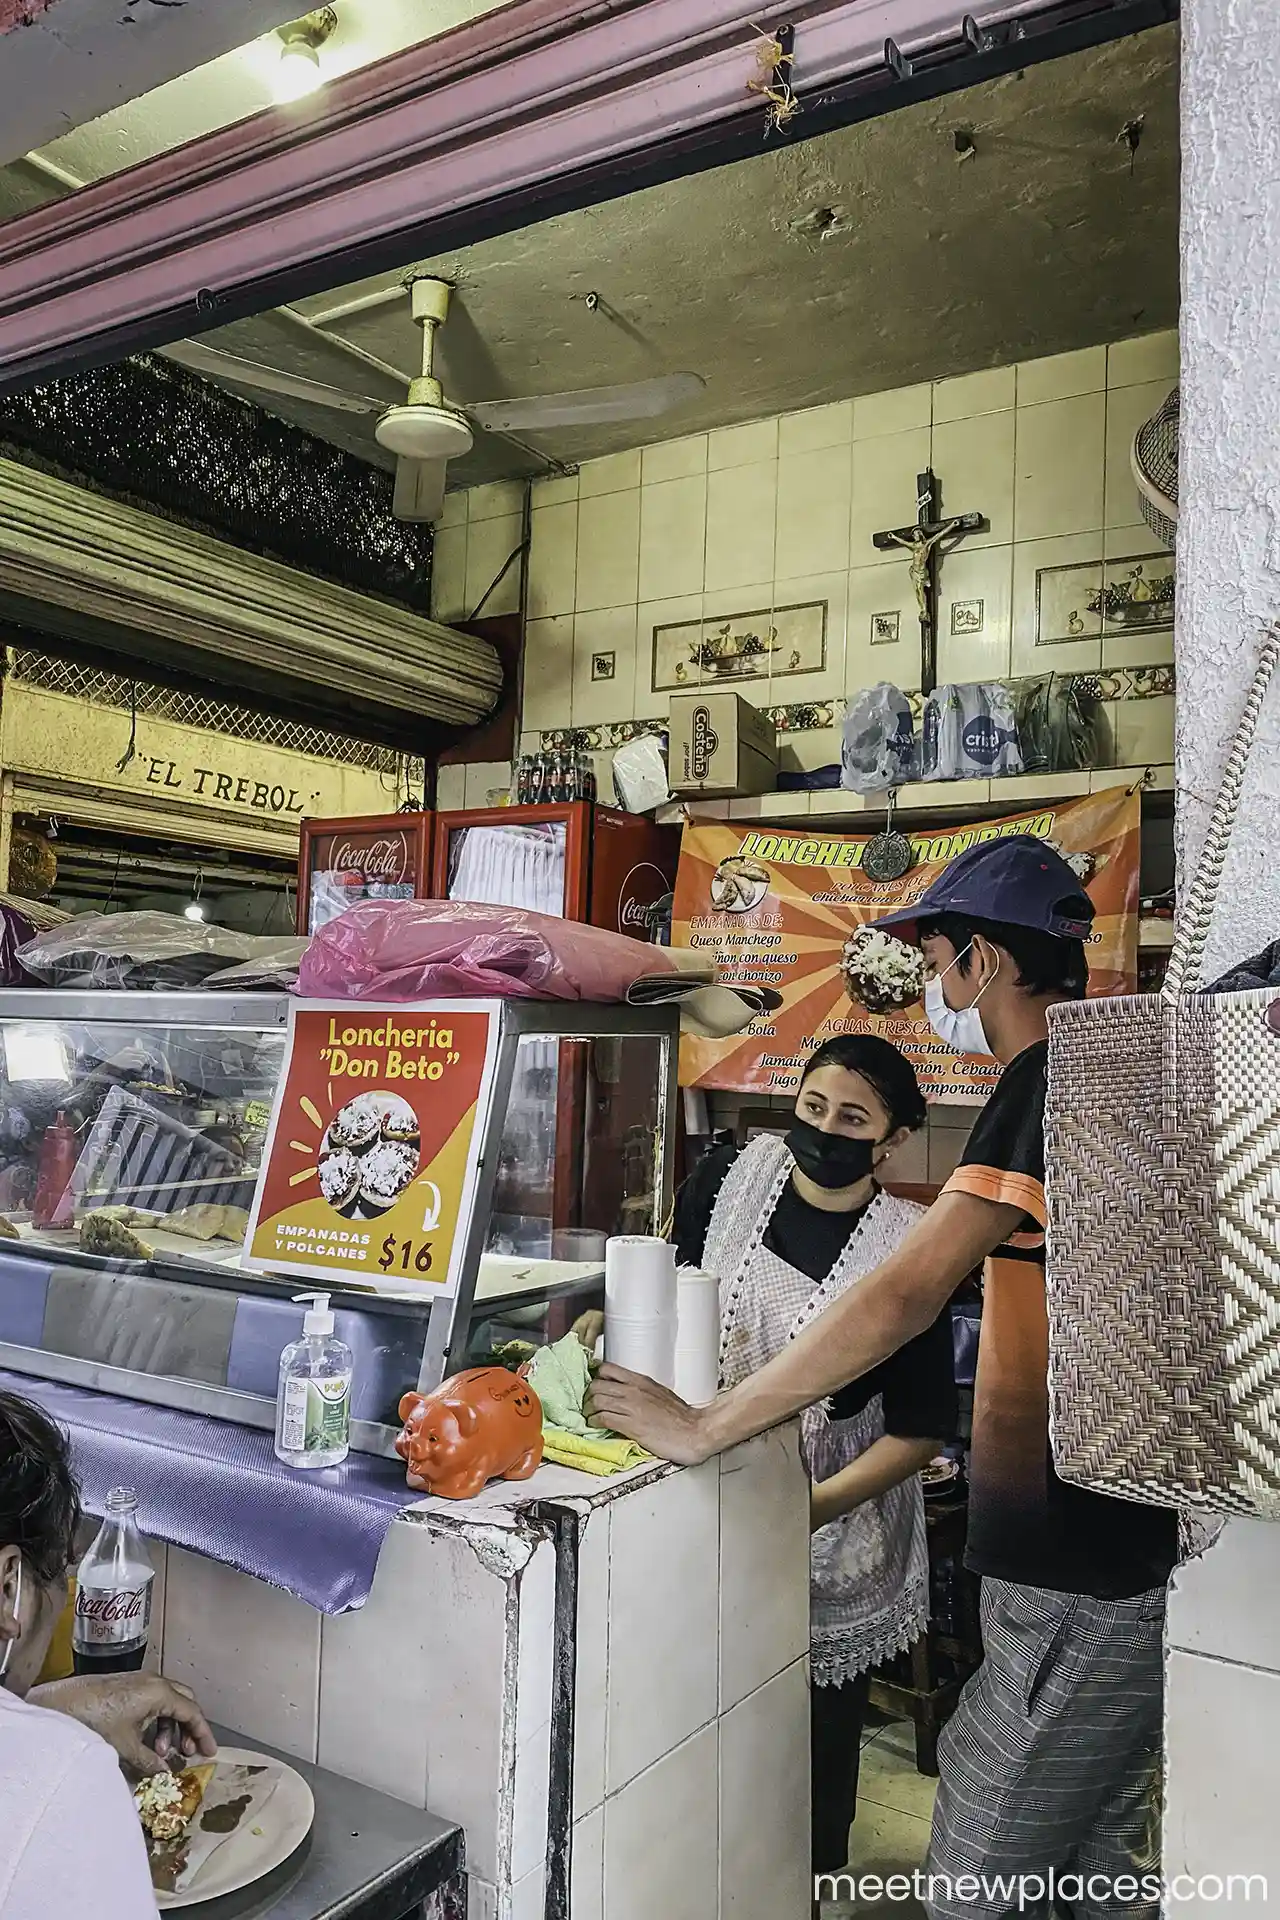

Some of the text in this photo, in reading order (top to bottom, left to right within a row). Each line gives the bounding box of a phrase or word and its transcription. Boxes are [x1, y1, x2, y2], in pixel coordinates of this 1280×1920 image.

[695, 713, 708, 773] Costeña
[706, 737, 714, 750] La
[911, 831, 975, 866] DON
[333, 839, 402, 876] Coca-Cola
[893, 896, 903, 904] o
[905, 888, 925, 903] Fri
[689, 913, 785, 929] EMPANADAS DE:
[689, 933, 783, 949] Queso Manchego
[738, 953, 759, 963] con
[761, 952, 798, 966] queso
[737, 967, 783, 984] chorizo
[327, 1017, 454, 1049] Loncheria
[747, 1021, 776, 1036] Bola
[820, 1018, 938, 1036] AGUAS FRESCA
[767, 1071, 799, 1088] Jugo
[918, 1082, 995, 1097] emporada
[276, 1224, 371, 1245] EMPANADAS
[275, 1239, 368, 1261] Y POLCANES
[377, 1232, 434, 1272] $16
[75, 1587, 146, 1622] Coca-Cola
[91, 1622, 115, 1638] light
